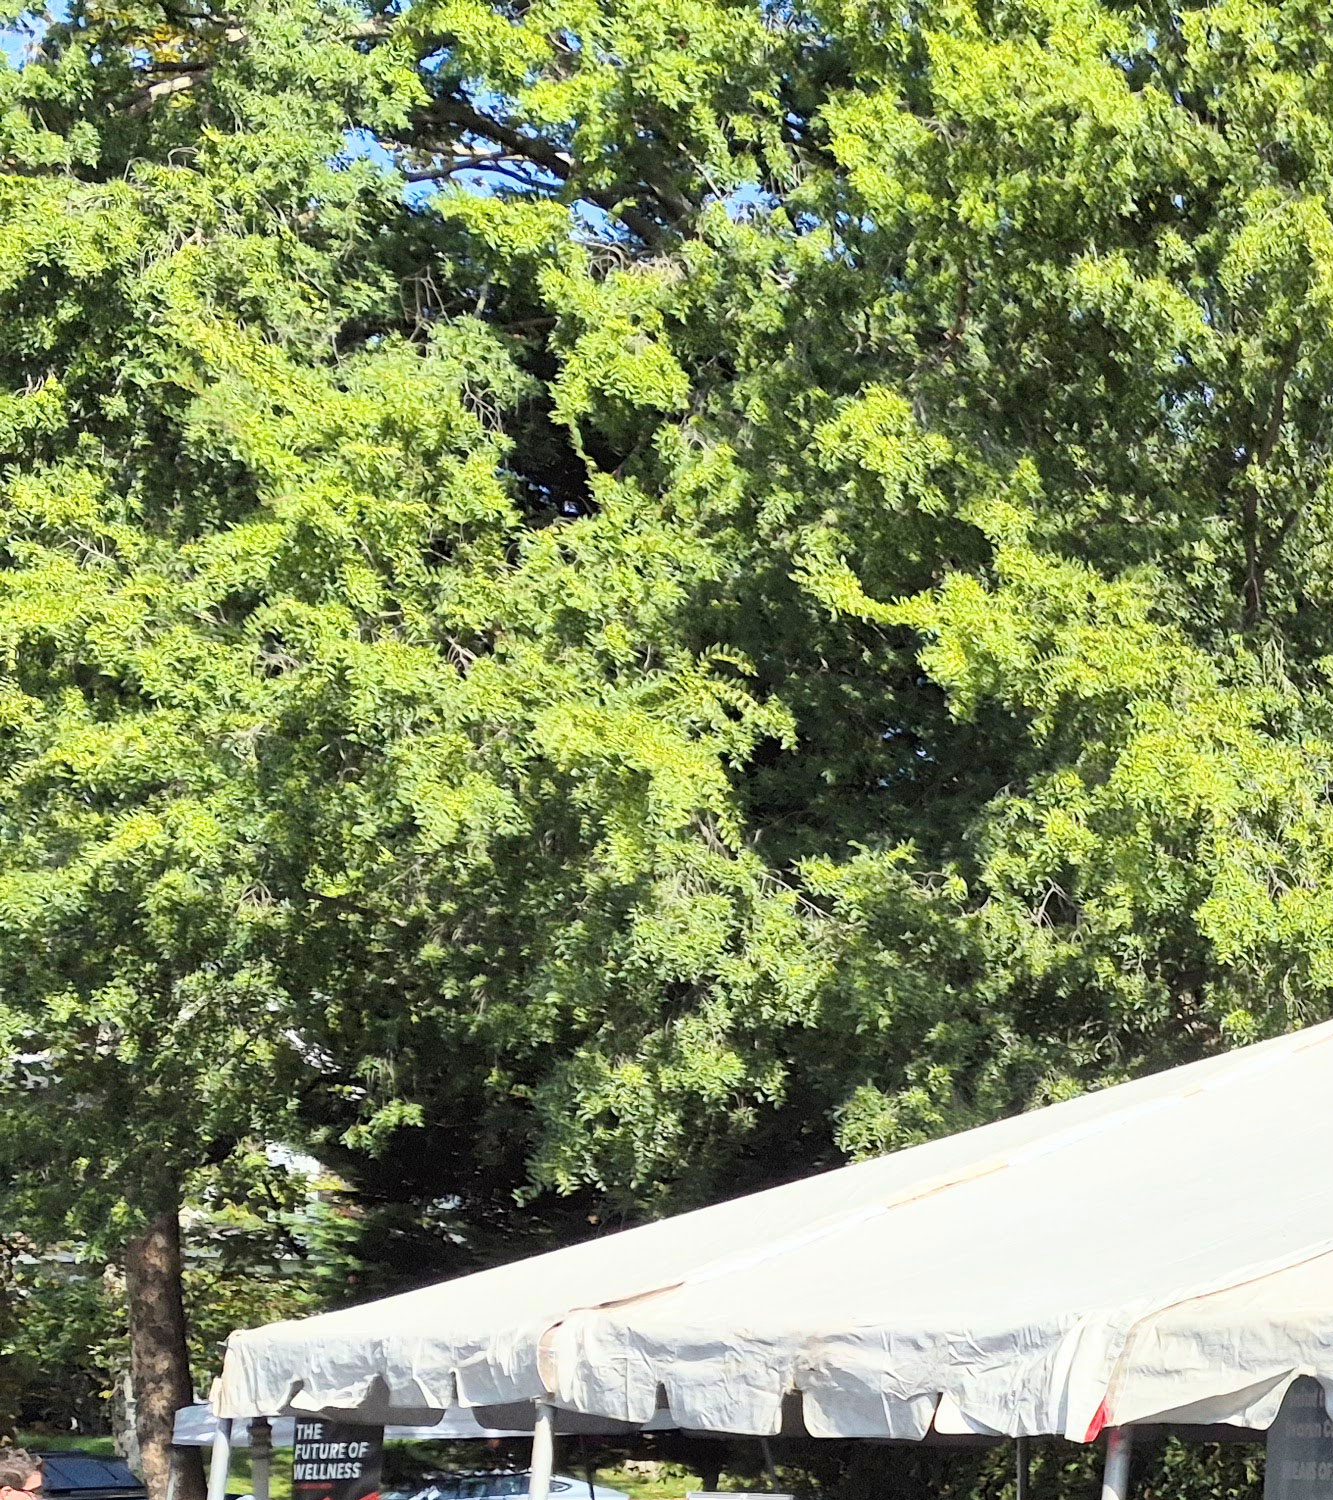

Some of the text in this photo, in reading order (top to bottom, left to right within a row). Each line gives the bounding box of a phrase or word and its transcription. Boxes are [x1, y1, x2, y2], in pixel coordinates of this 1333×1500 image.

[296, 1423, 323, 1440] THE
[295, 1442, 370, 1460] FUTURE OF
[294, 1462, 362, 1481] WELLNESS
